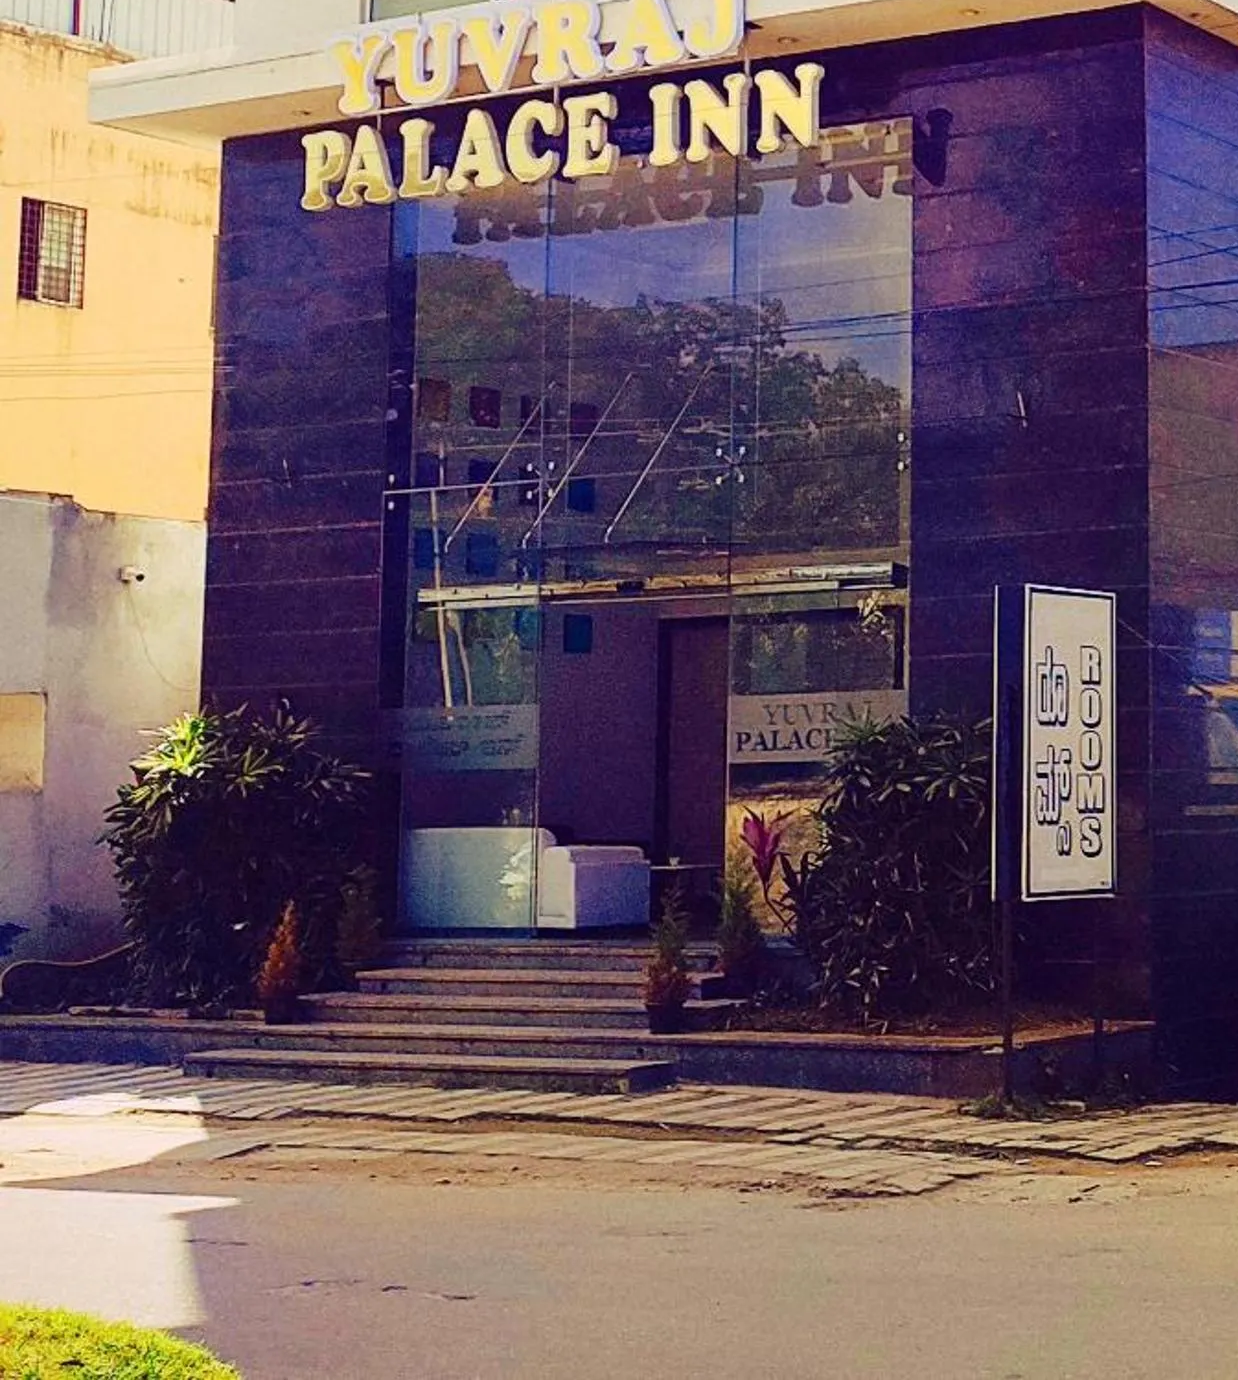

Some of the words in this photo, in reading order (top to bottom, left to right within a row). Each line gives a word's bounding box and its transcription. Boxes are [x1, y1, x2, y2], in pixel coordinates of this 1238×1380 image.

[300, 93, 617, 211] PALACE
[648, 63, 825, 166] INN
[1076, 646, 1105, 857] ROOMS
